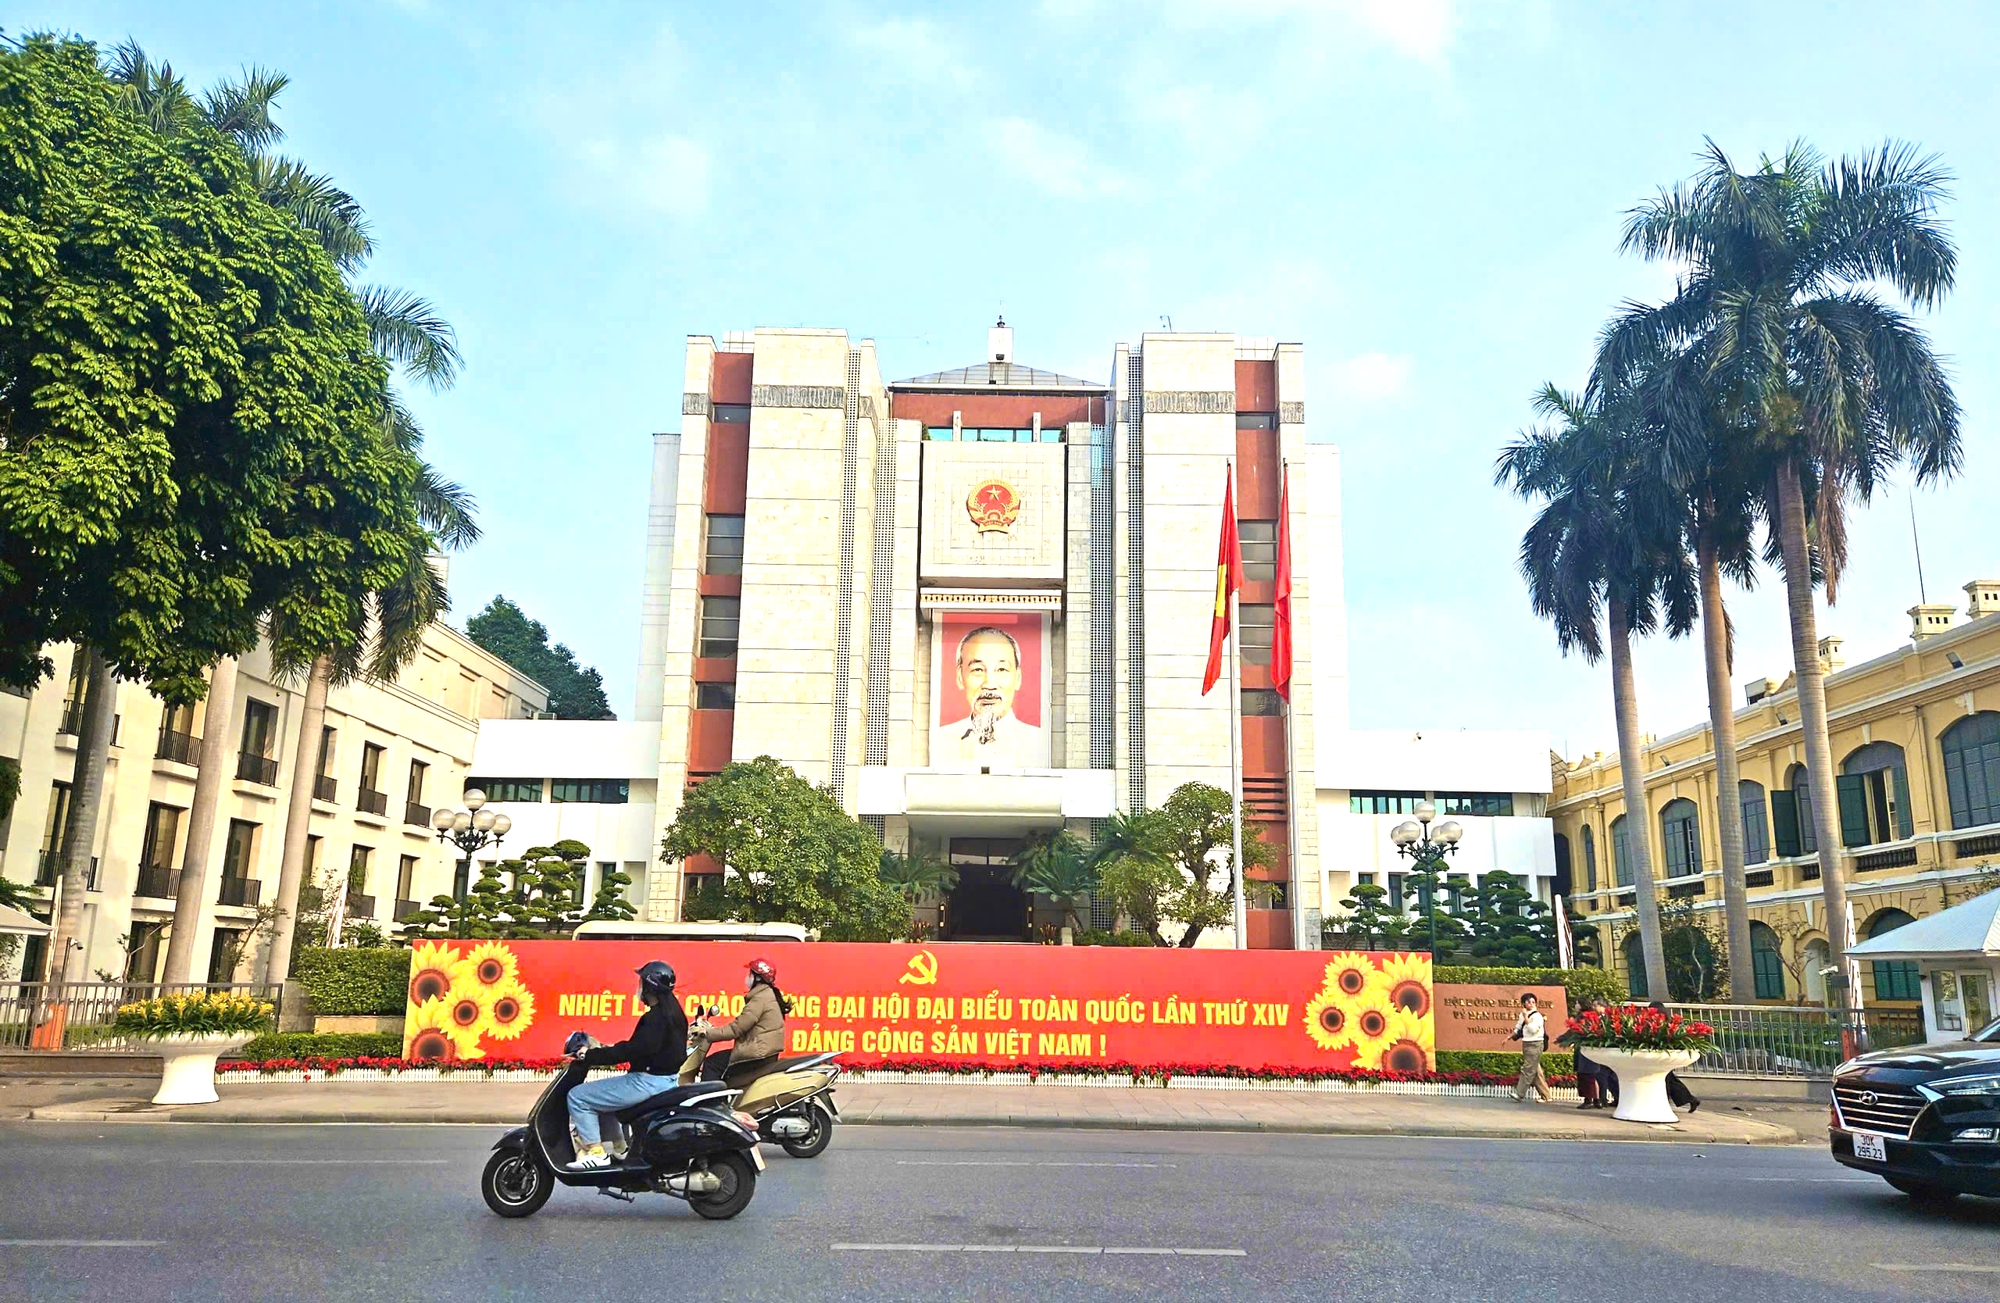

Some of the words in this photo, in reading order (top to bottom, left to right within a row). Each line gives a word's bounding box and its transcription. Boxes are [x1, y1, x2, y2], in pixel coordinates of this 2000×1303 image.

[559, 990, 626, 1022] NHIỆT
[684, 990, 746, 1018] CHÀO
[827, 995, 865, 1023] ĐẠI
[872, 992, 909, 1024] HỘI
[916, 996, 954, 1025] ĐẠI
[962, 990, 1012, 1021] BIỂU
[1019, 994, 1077, 1022] TOÀN
[1086, 993, 1145, 1024] QUỐC
[1153, 994, 1196, 1025] LẦN
[1203, 1000, 1248, 1026] THỨ
[1253, 1003, 1289, 1026] XIV
[792, 1023, 854, 1053] ĐẢNG
[862, 1027, 923, 1057] CỘNG
[931, 1025, 977, 1054] SẢN
[985, 1028, 1032, 1059] VIỆT
[1039, 1033, 1091, 1056] NAM
[1100, 1034, 1107, 1056] !
[1861, 1134, 1875, 1147] 30K
